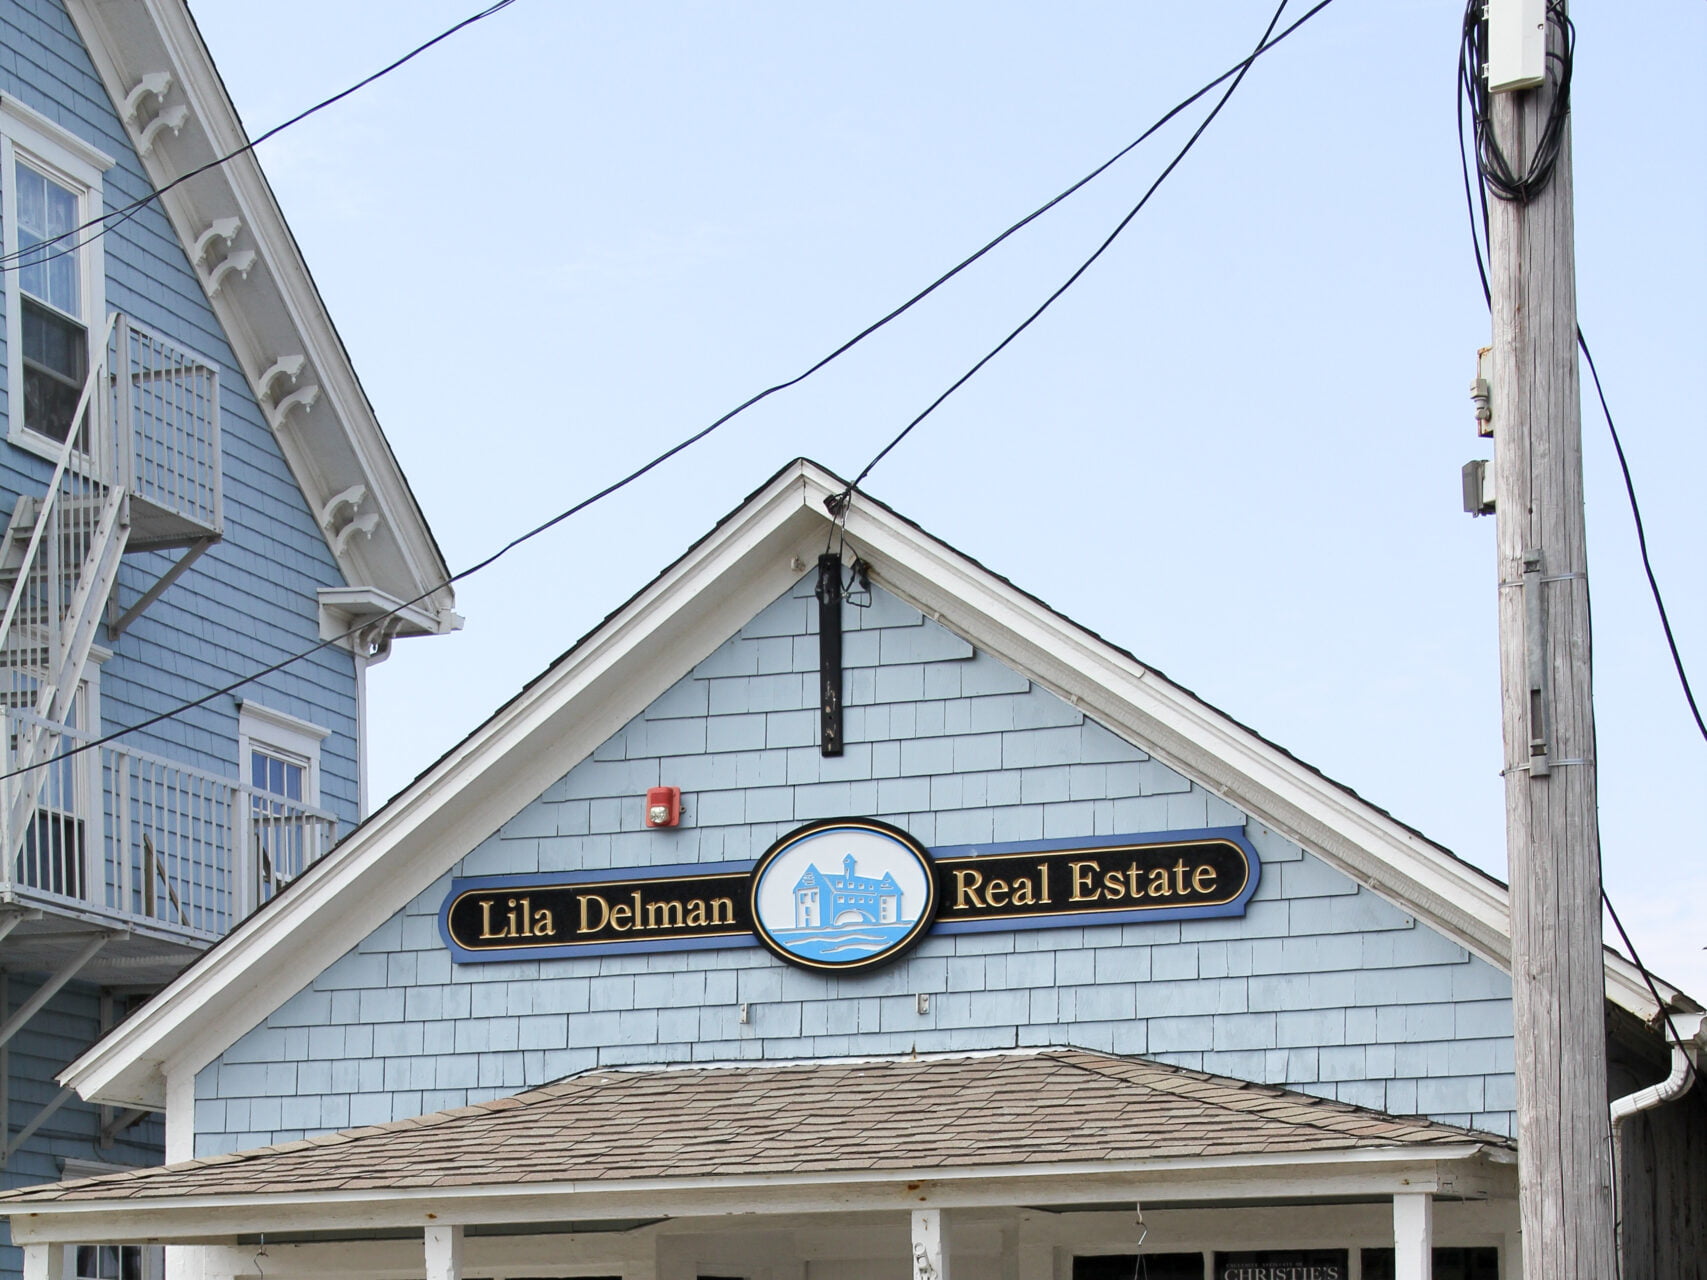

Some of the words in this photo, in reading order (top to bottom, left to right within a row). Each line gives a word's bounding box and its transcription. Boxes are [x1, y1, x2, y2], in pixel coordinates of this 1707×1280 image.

[478, 896, 557, 939] Lila
[575, 889, 737, 935] Delman
[952, 861, 1053, 910] Real
[1067, 857, 1218, 903] Estate
